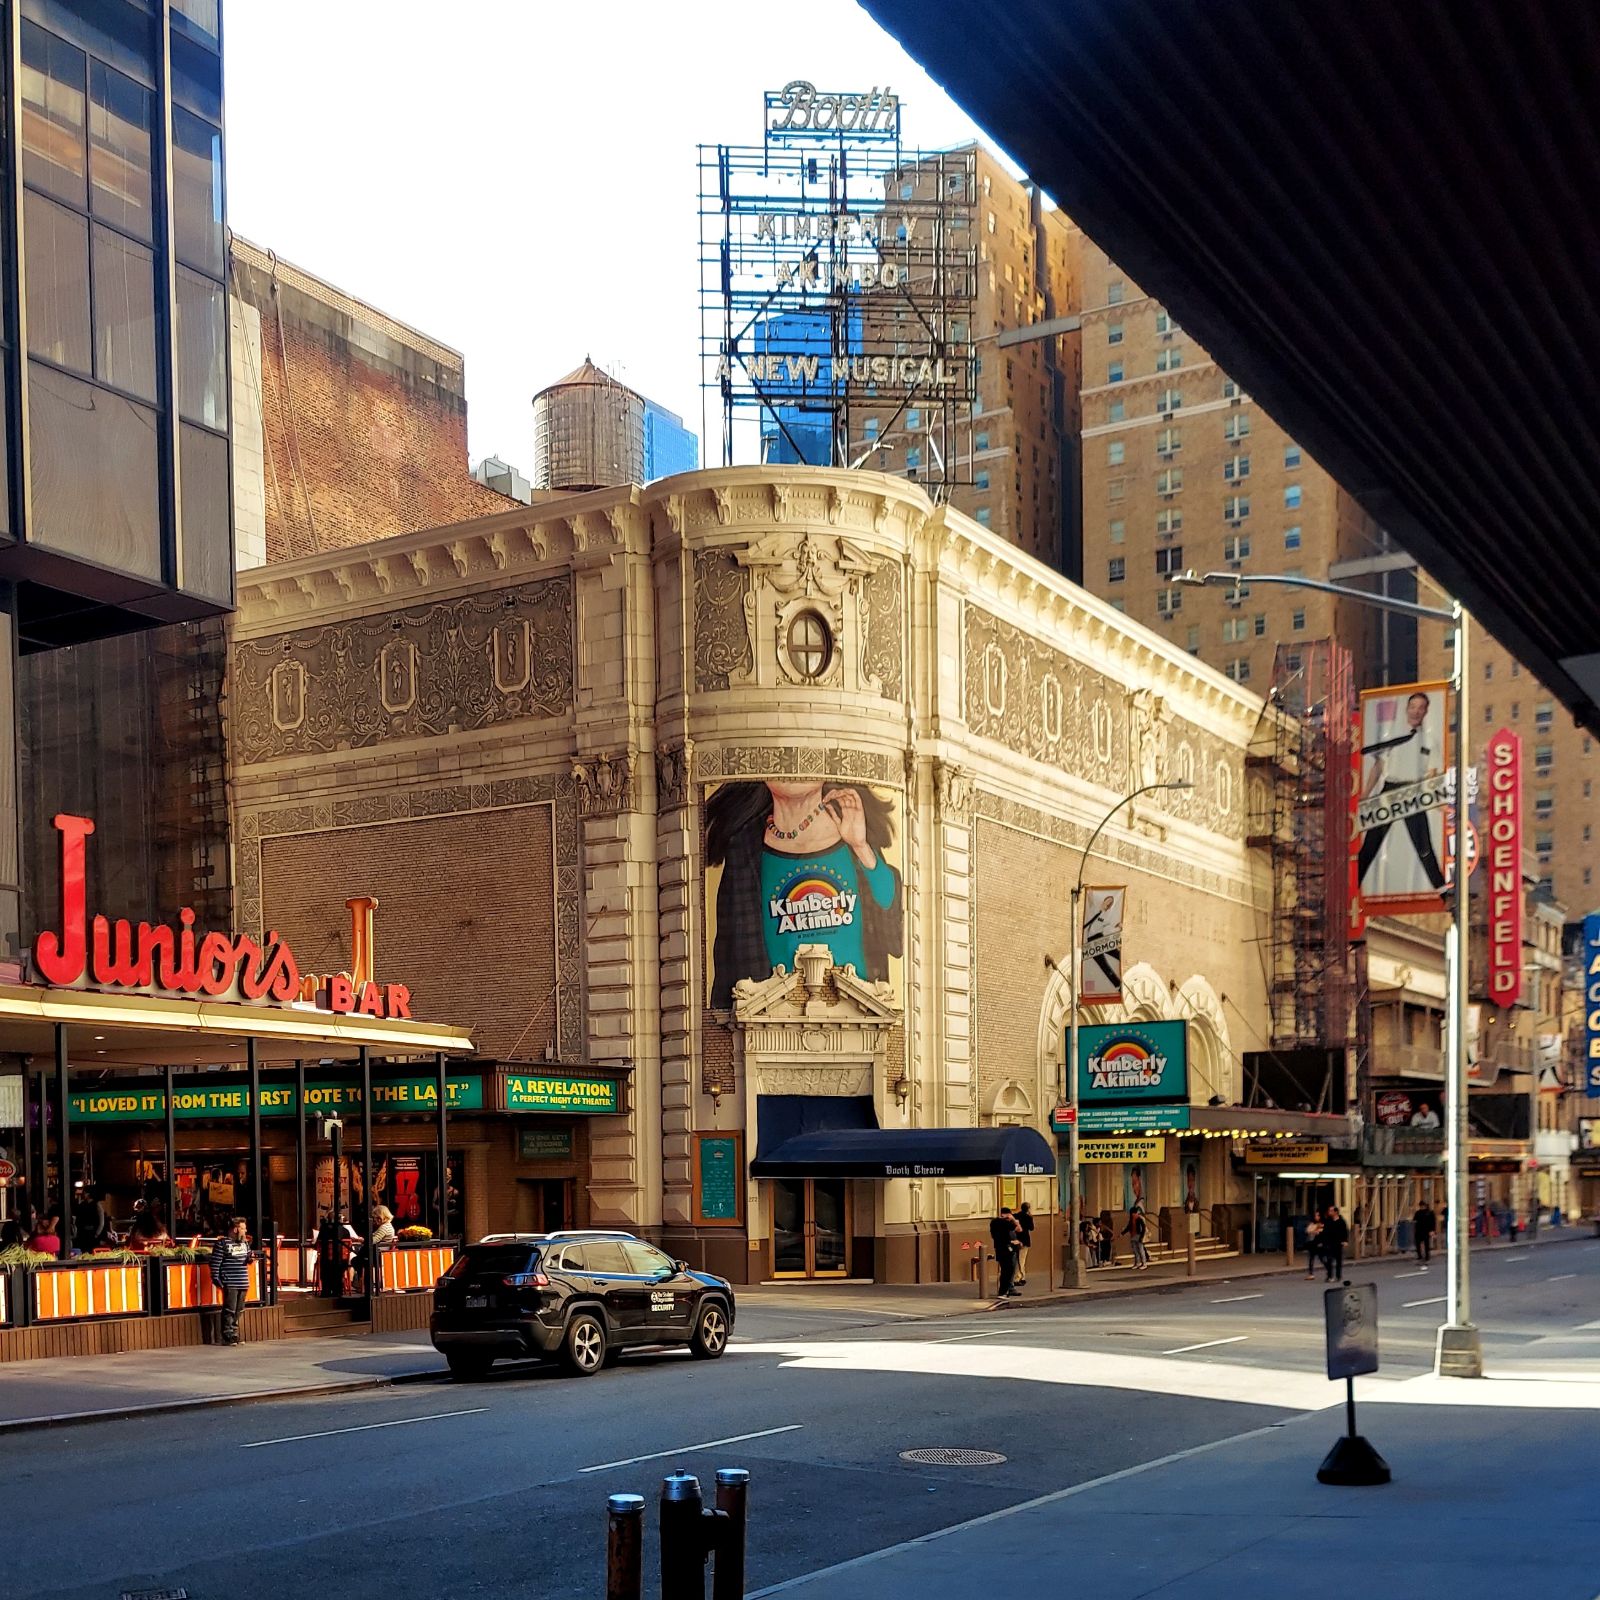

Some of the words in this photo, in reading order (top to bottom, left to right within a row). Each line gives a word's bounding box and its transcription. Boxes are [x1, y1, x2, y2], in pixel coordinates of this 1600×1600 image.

[772, 80, 899, 131] Booth
[757, 212, 919, 242] KIMBERLY
[776, 260, 900, 289] AKIMBO
[715, 353, 731, 381] A
[747, 355, 819, 383] NEW
[831, 357, 957, 384] MUSICAL
[1360, 786, 1449, 828] MORMON
[1493, 744, 1516, 992] SCHOENFELD
[34, 814, 300, 1002] Junior's
[770, 890, 857, 917] Kimberly
[777, 909, 853, 934] Akimbo
[1082, 936, 1122, 959] MORMON
[328, 977, 412, 1018] BAR
[1088, 1054, 1167, 1074] Kimberly
[527, 1080, 613, 1097] REVELATION.
[1092, 1070, 1161, 1088] Akimbo
[89, 1097, 137, 1112] LOVED
[141, 1096, 157, 1110] IT
[162, 1094, 206, 1109] ROM
[209, 1092, 241, 1107] THE
[373, 1085, 408, 1101] THE
[519, 1095, 548, 1103] PERFECT
[550, 1096, 571, 1105] NIGHT
[572, 1097, 581, 1105] OF
[1078, 1142, 1125, 1151] PREVIEWS
[1128, 1142, 1156, 1150] BEGIN
[1085, 1150, 1133, 1159] OCTOBER
[1138, 1150, 1148, 1158] 12
[885, 1165, 910, 1175] Booth
[914, 1165, 945, 1175] Theatre
[1014, 1163, 1027, 1174] Booth
[1028, 1163, 1044, 1174] Theatre
